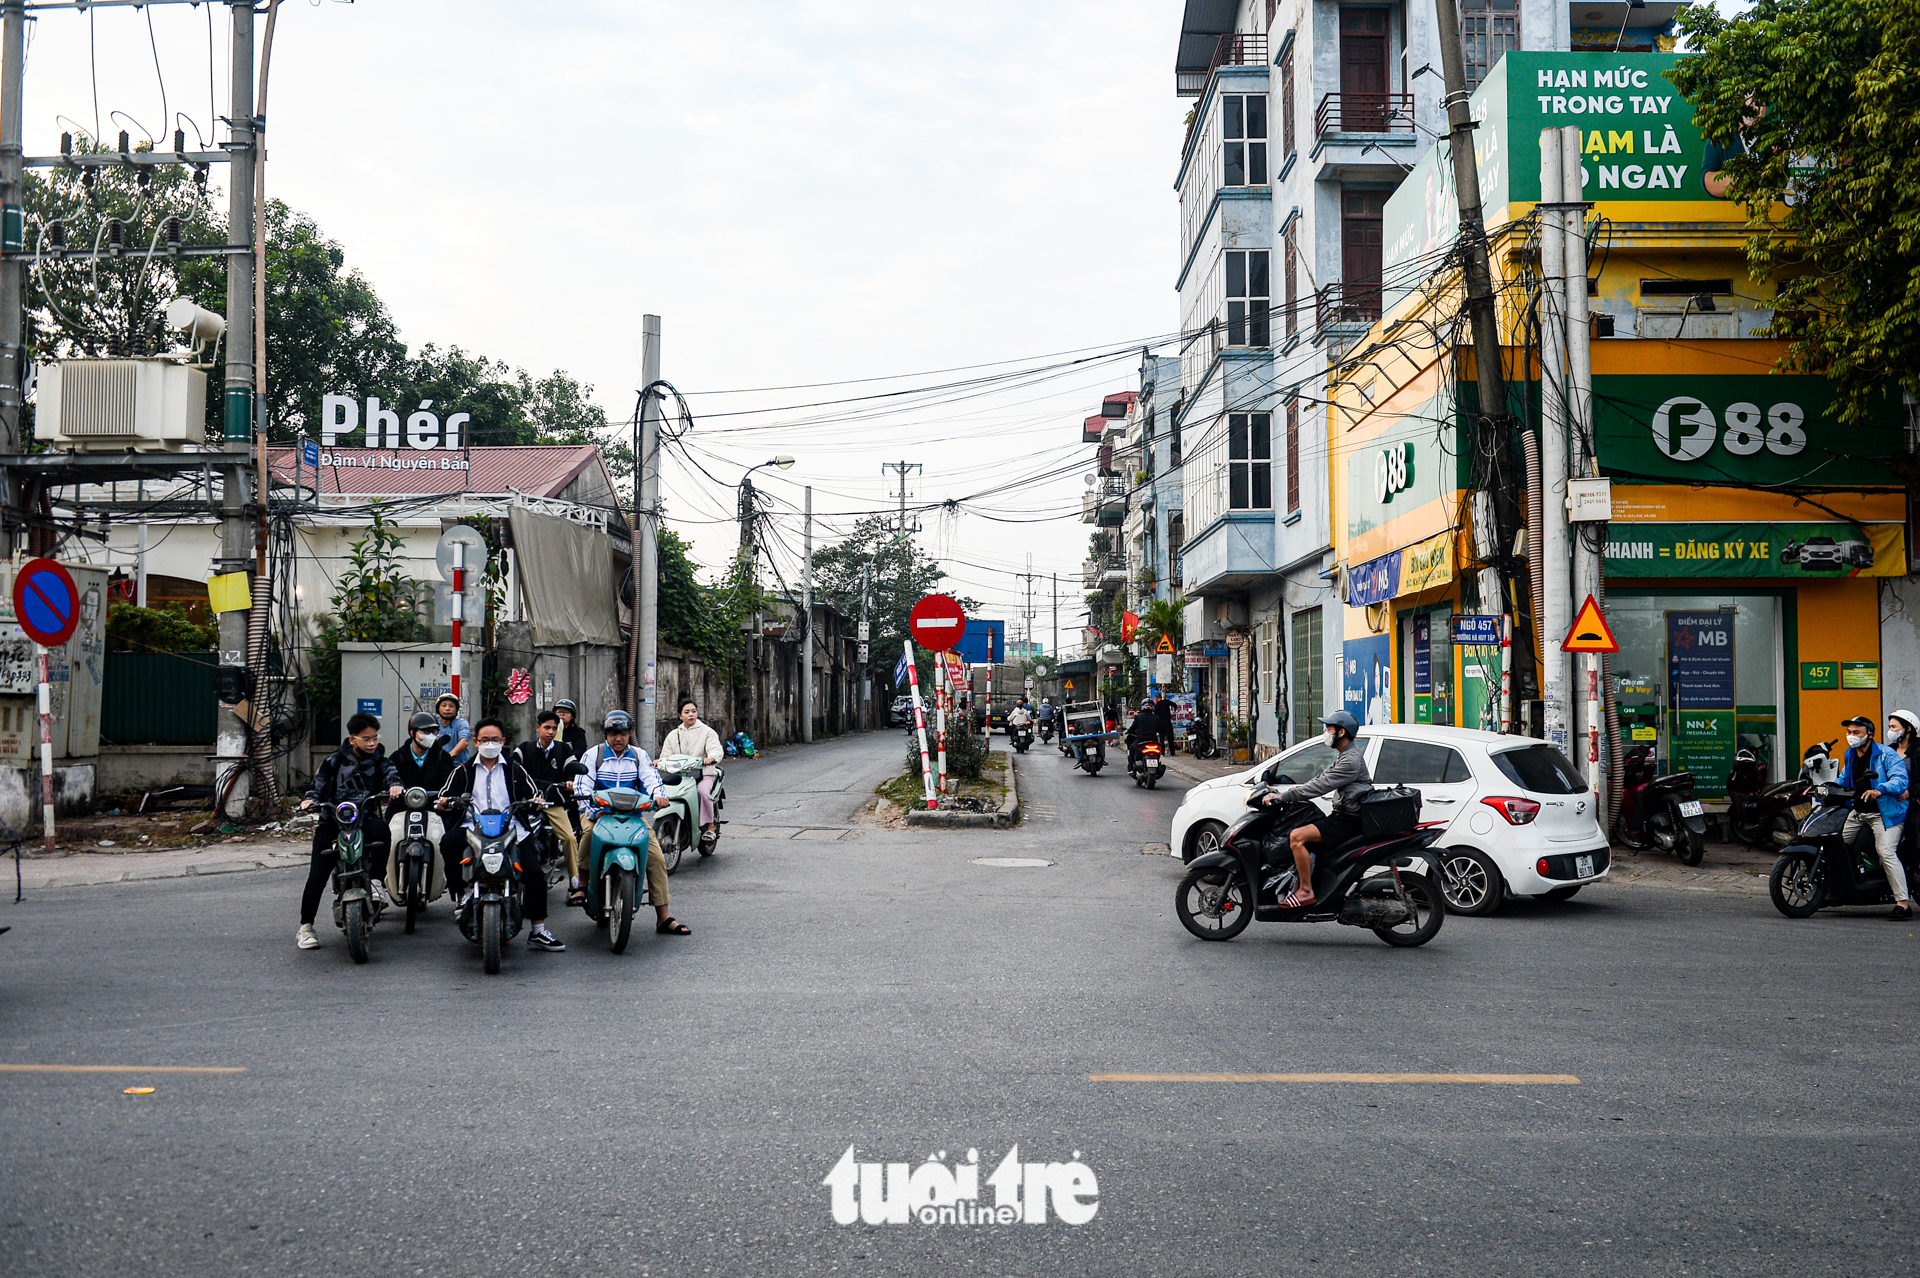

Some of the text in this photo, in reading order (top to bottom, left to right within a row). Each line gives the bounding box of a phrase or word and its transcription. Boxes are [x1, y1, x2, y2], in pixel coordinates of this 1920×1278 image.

[1537, 65, 1649, 94] HẠN MỨC
[1537, 95, 1673, 115] TRONG TAY
[1643, 124, 1682, 154] LÀ
[1598, 164, 1688, 189] NGAY
[321, 395, 471, 451] Phér
[1652, 396, 1807, 461] F88
[320, 453, 470, 474] Đậm Vị Nguyên Bản
[1675, 539, 1720, 559] ĐĂNG
[1724, 539, 1744, 559] KÝ
[1749, 542, 1769, 558] XE
[1460, 617, 1493, 631] NGÕ 457
[1678, 616, 1723, 627] ĐIỂM ĐẠI LÝ
[1698, 630, 1728, 646] MB
[1809, 666, 1830, 677] 457
[1621, 678, 1645, 687] Chạm
[1636, 686, 1652, 694] Vay
